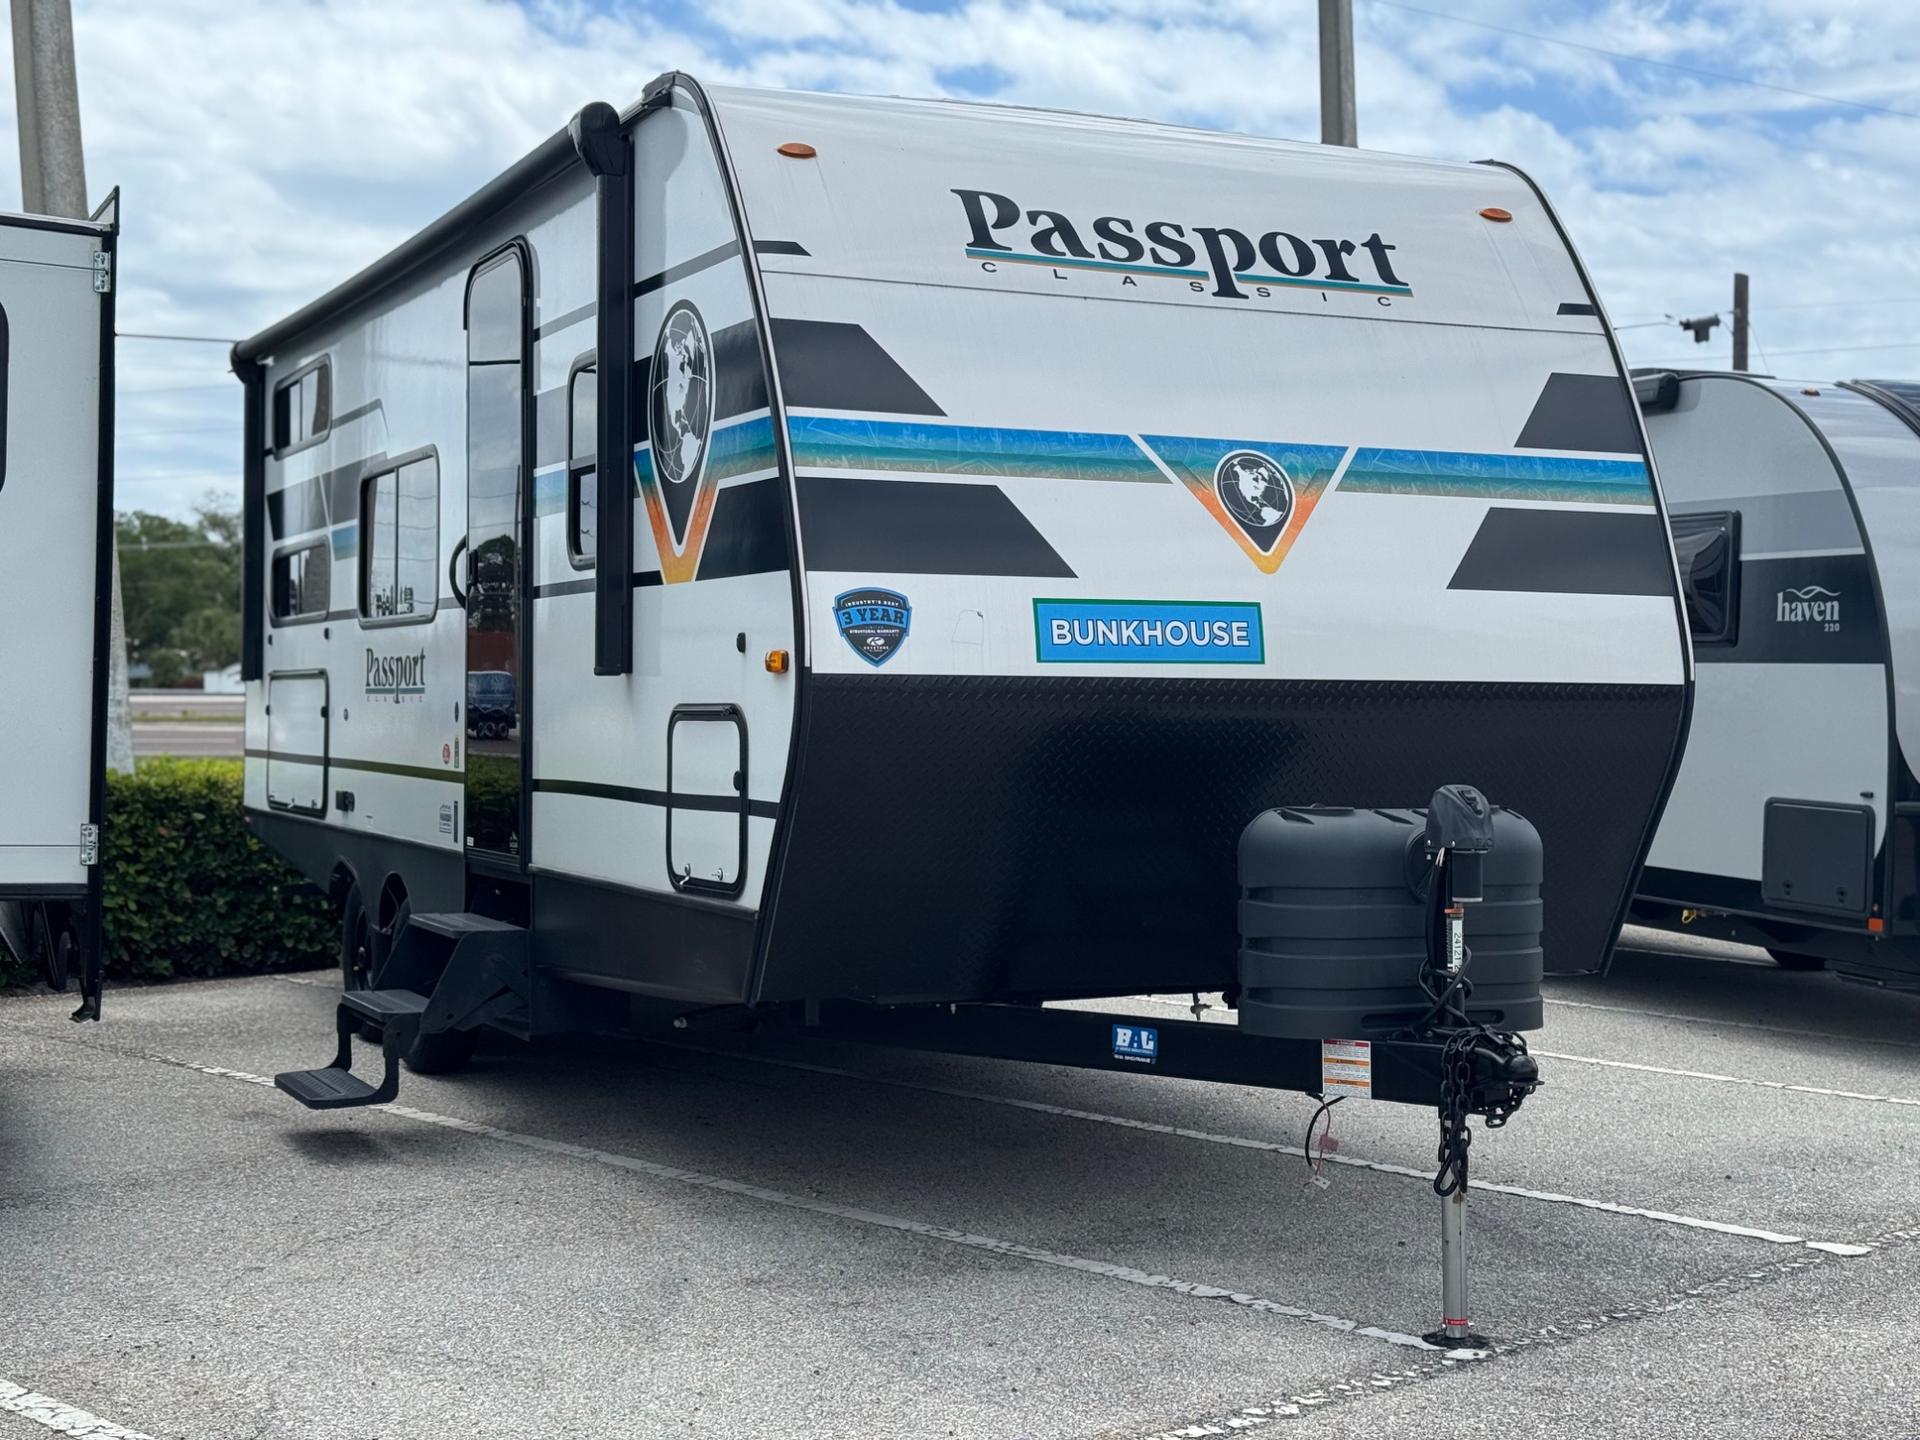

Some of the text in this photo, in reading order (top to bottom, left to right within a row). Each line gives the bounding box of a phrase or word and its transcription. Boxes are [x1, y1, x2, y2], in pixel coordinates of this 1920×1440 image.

[950, 189, 1410, 299] Passport
[981, 262, 1392, 308] CLASSIC
[842, 607, 904, 625] 3 YEAR
[1775, 592, 1840, 622] haven
[1050, 618, 1250, 647] BUNKHOUSE
[1823, 623, 1840, 632] 220
[365, 648, 426, 704] Passport
